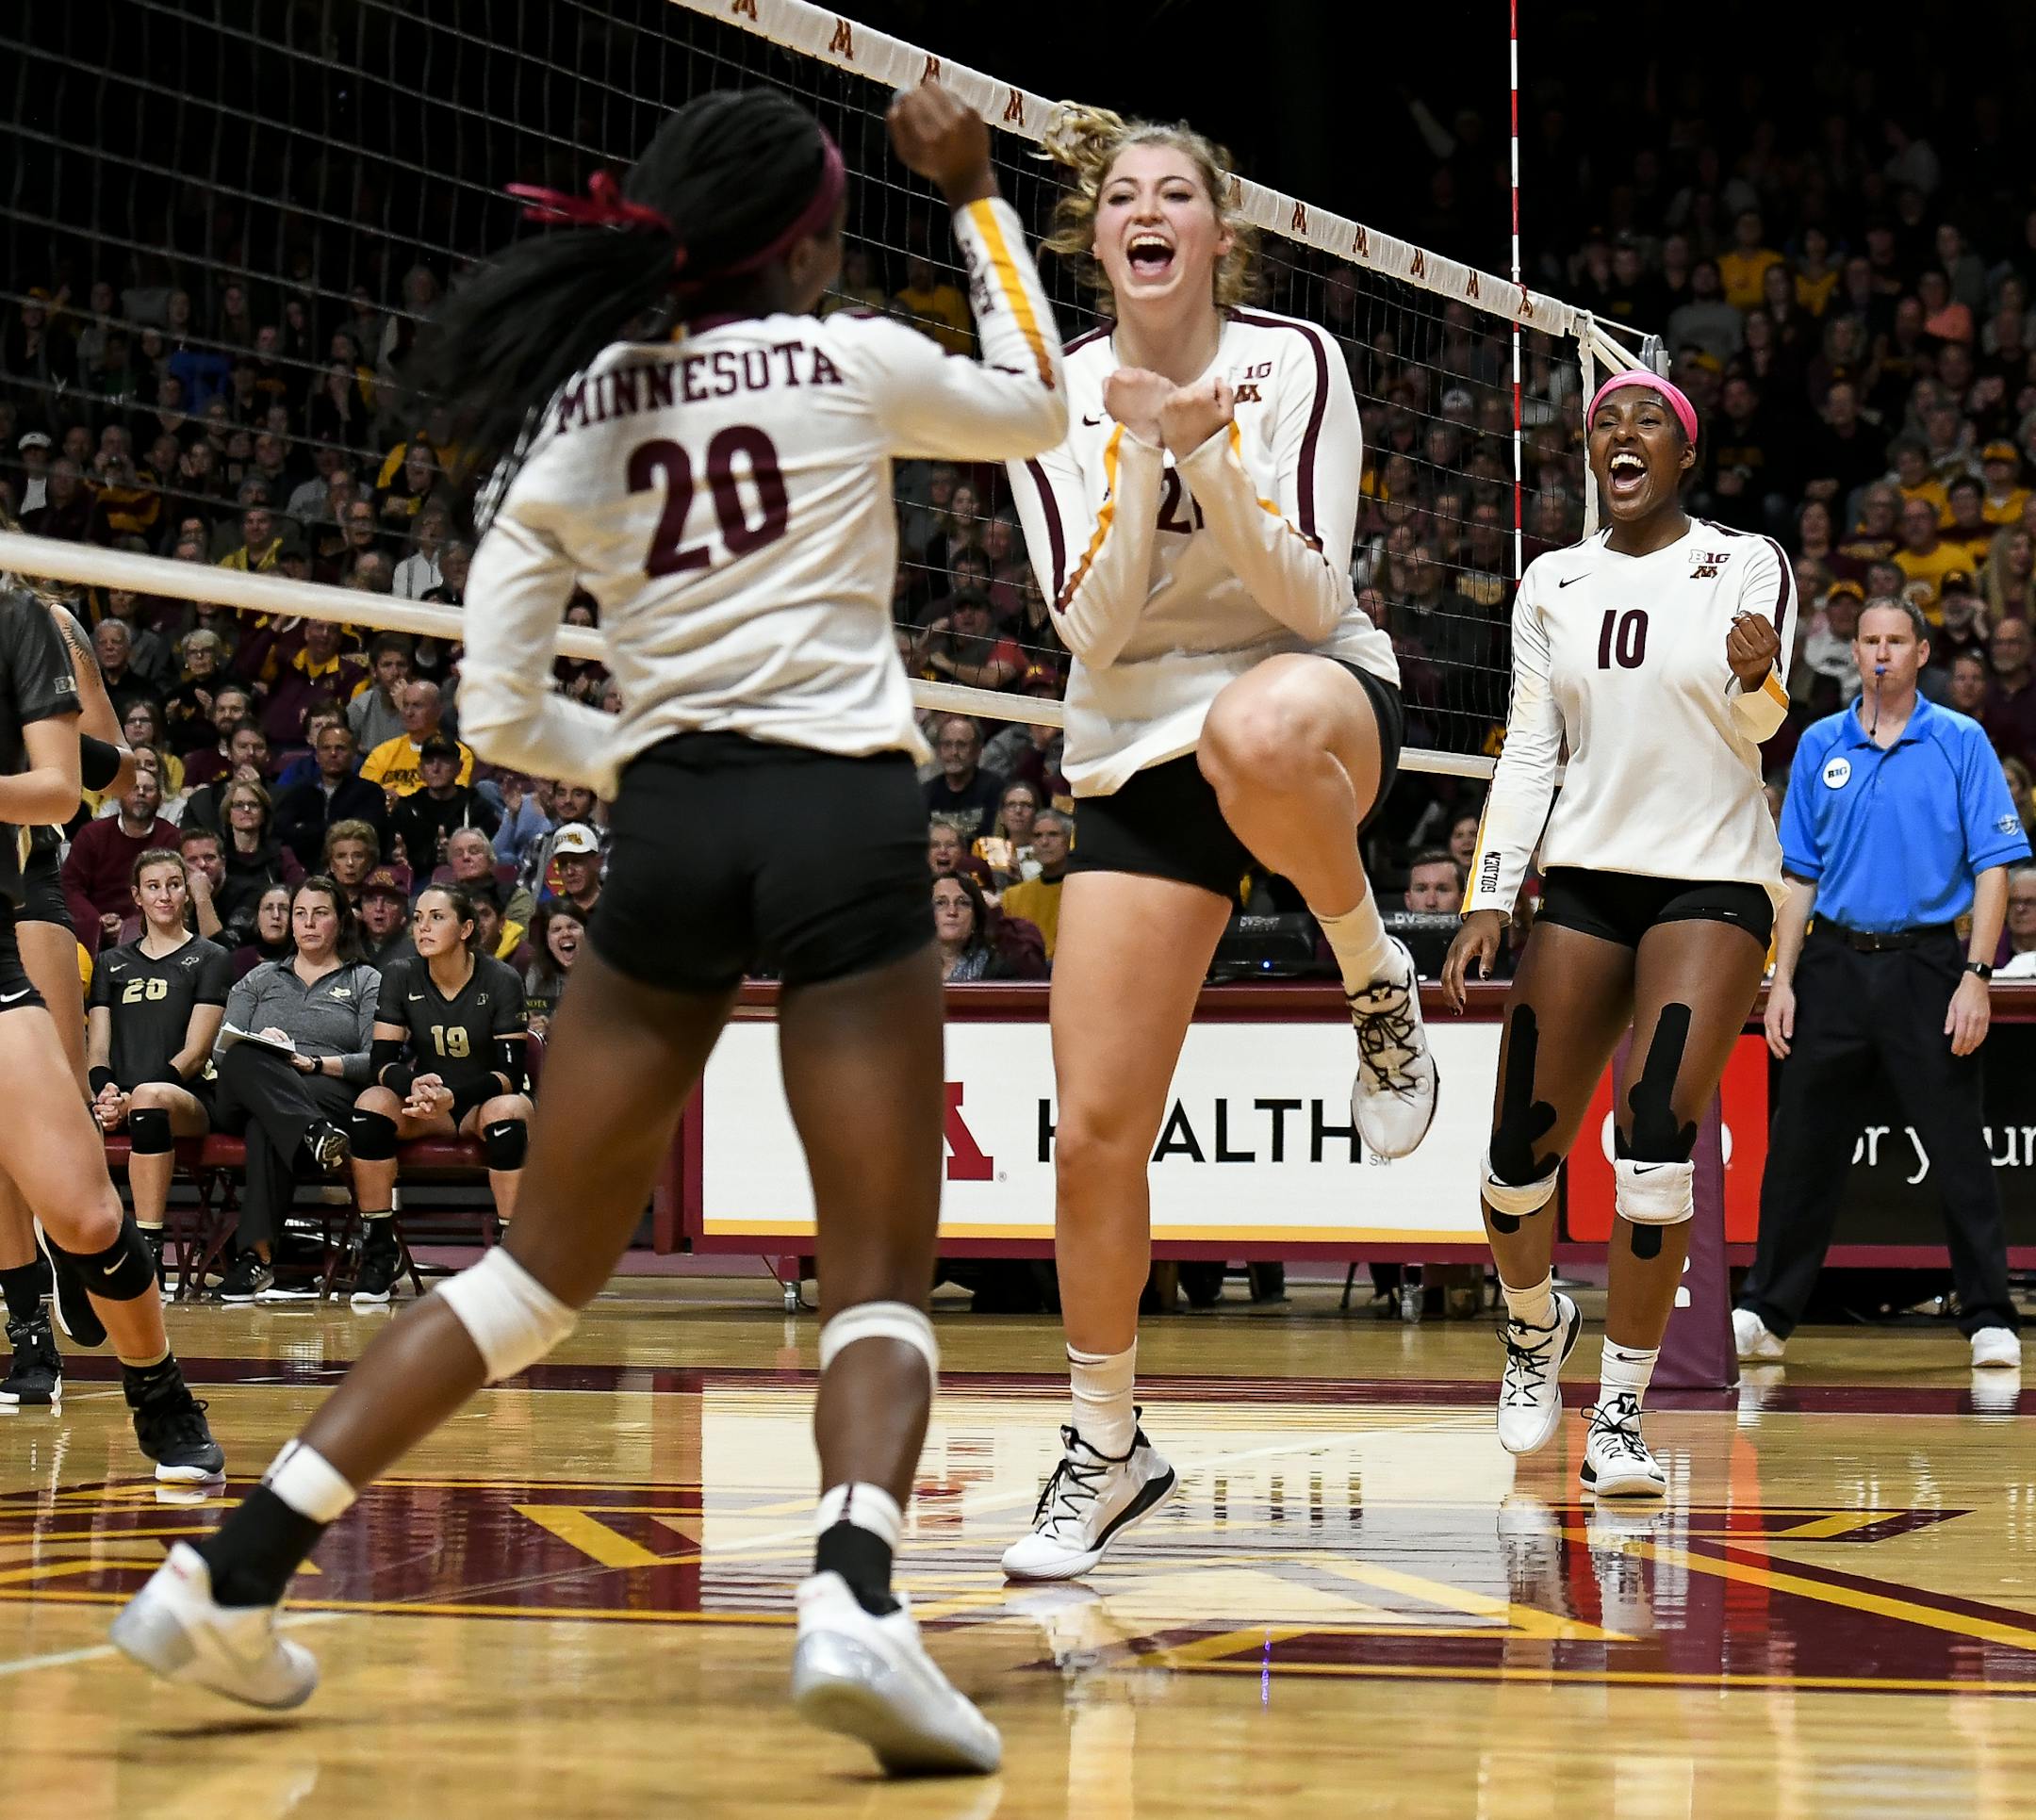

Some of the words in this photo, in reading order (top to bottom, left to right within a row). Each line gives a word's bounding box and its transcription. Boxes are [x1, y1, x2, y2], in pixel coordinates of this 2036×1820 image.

[556, 341, 843, 435] MINNESOTA
[626, 426, 789, 578] 20
[1598, 609, 1649, 670] 10
[1481, 851, 1502, 894] GOLDEN
[122, 977, 168, 1005] 20
[431, 1025, 471, 1058] 19
[1038, 1098, 1362, 1163] ALTH
[1903, 1125, 2036, 1185] yur
